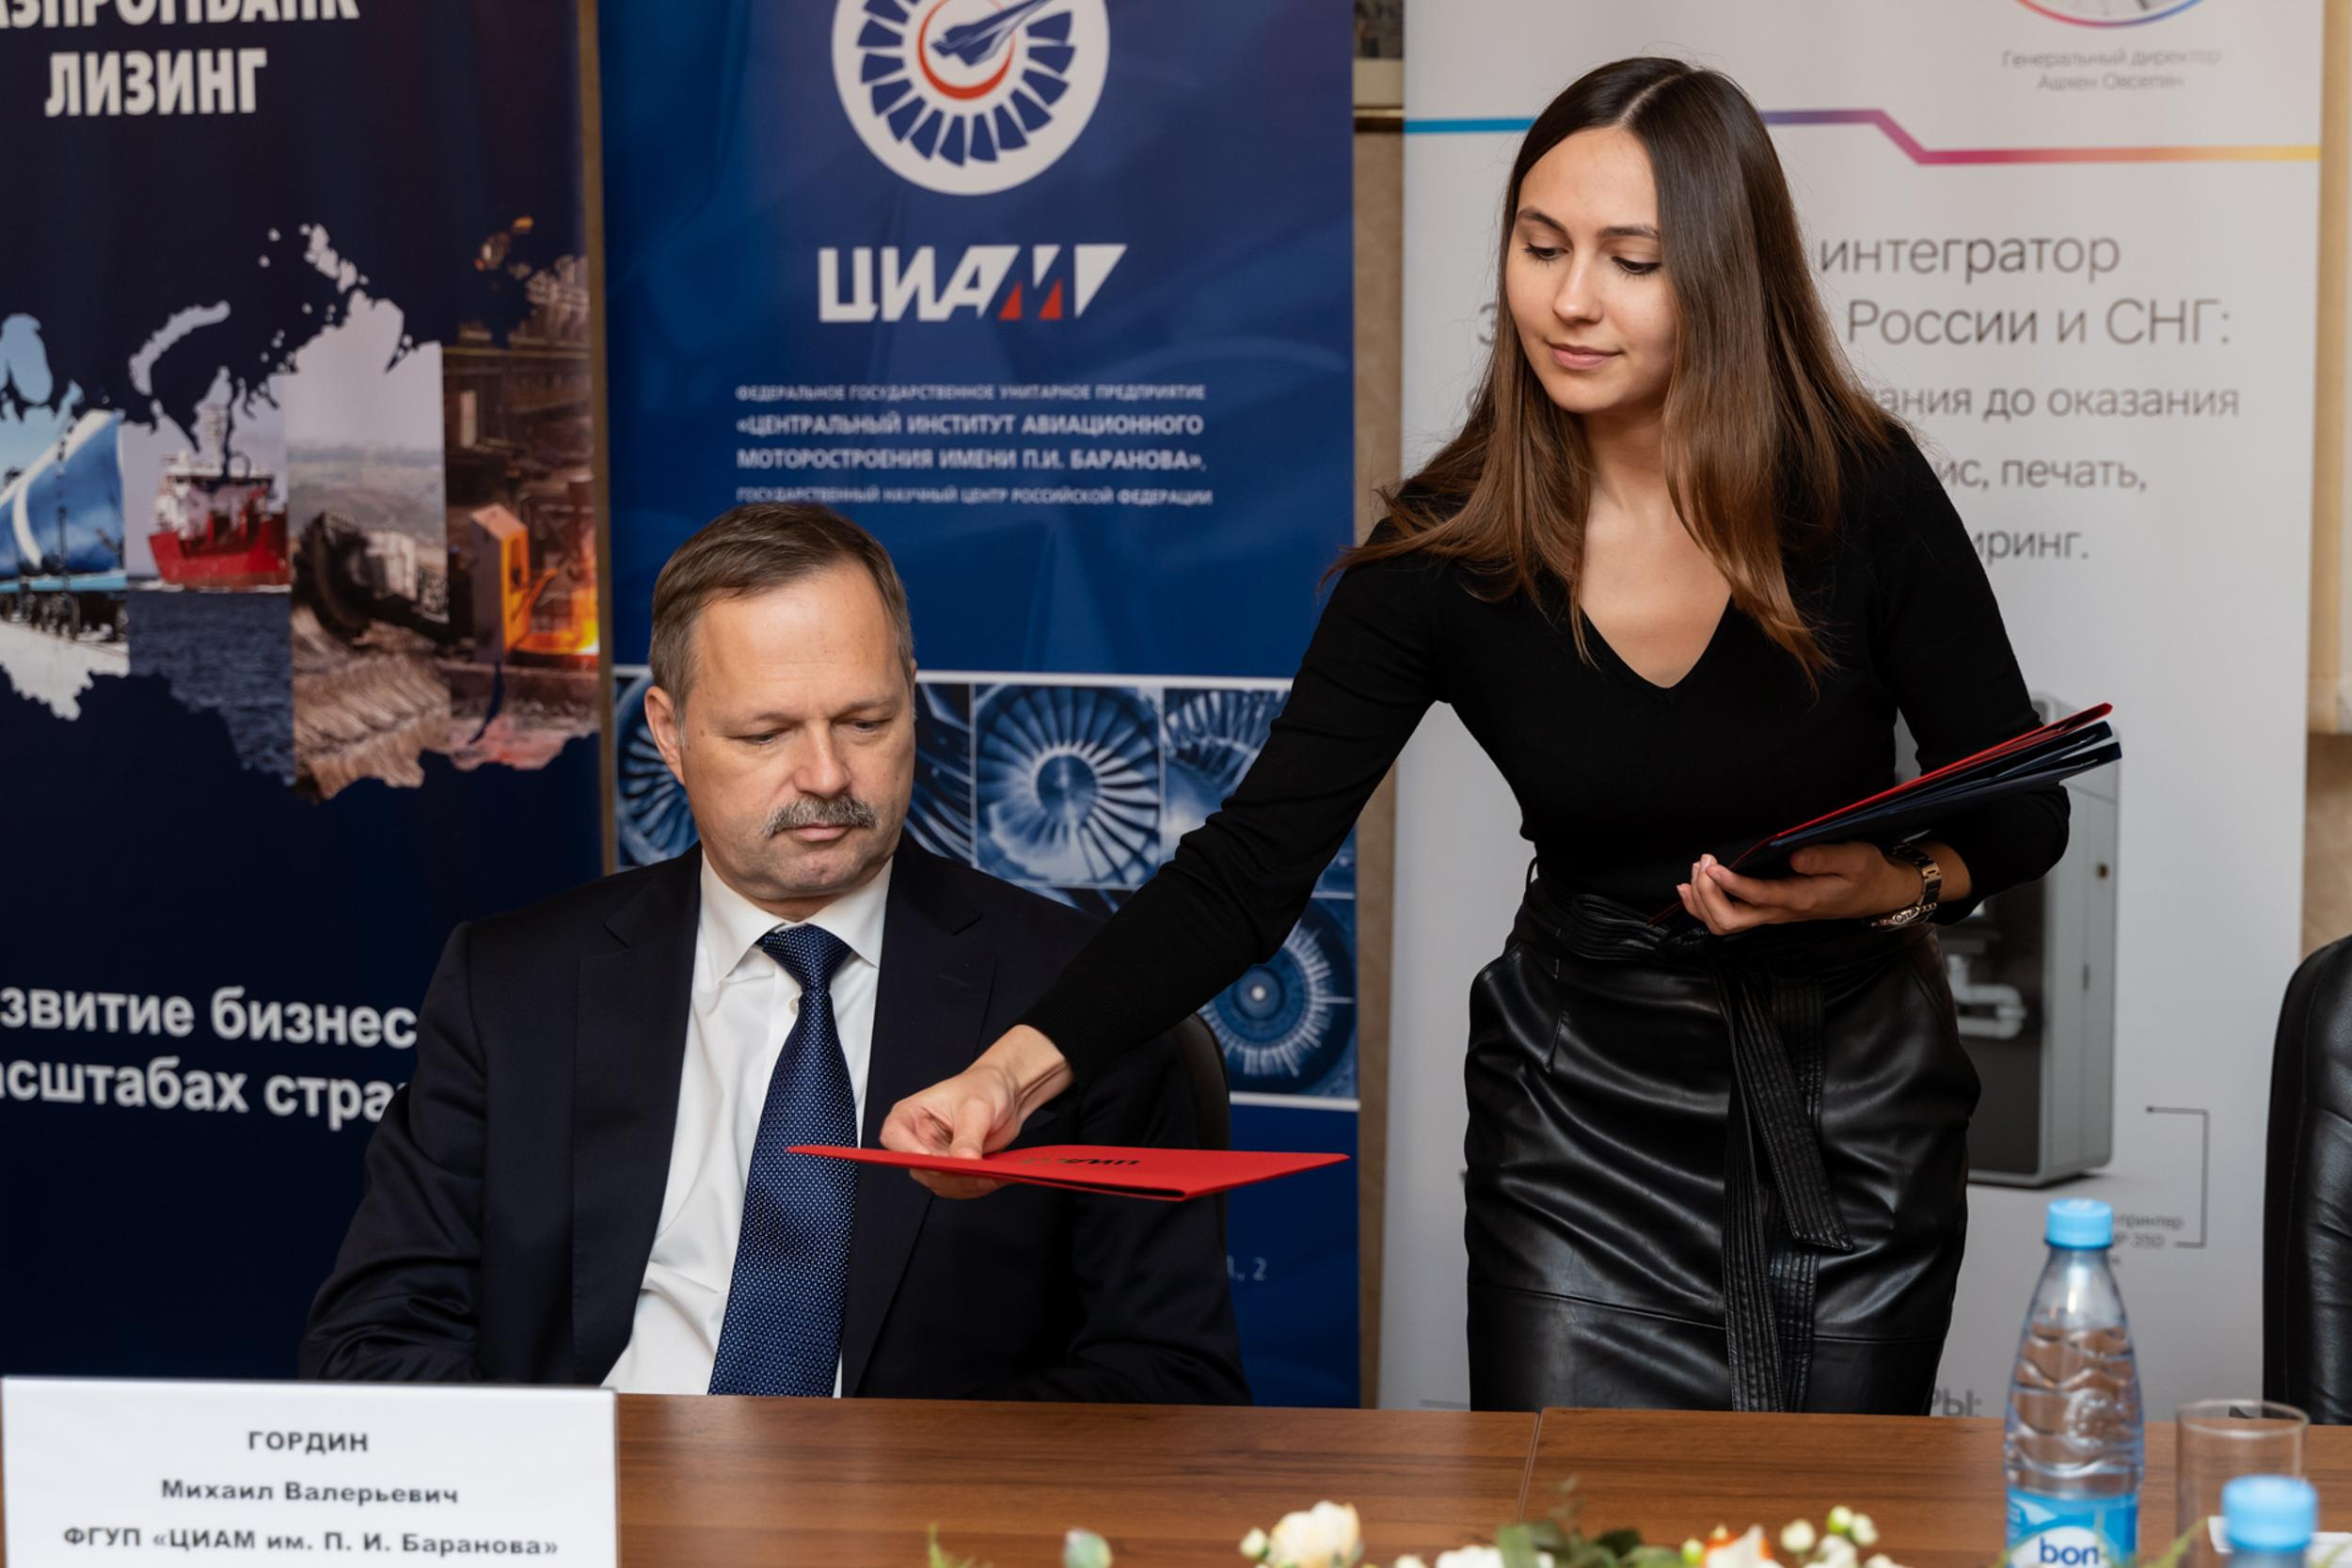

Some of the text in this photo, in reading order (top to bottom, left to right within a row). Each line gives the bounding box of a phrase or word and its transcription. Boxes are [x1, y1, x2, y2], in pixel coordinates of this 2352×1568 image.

[44, 47, 268, 118] ЛИЗИНГ
[1820, 237, 2122, 283] интегратор
[1847, 297, 2230, 345] России и СНГ:
[735, 384, 1205, 402] ФЕДЕРАЛЬНОЕ ГОСУДАРСТВЕННОЕ УНИТАРНОЕ ПРЕДПРИЯТИЕ
[1868, 387, 2239, 421] ания до оказания
[737, 411, 1204, 437] «ЦЕНТРАЛЬНЫЙ ИНСТИТУТ АВИАЦИОННОГО
[737, 449, 933, 469] МОТОРОСТРОЕНИЯ
[940, 449, 1017, 468] ИМЕНИ
[1023, 449, 1064, 468] П.И.
[2000, 458, 2147, 493] печать,
[1011, 485, 1114, 505] РОССИЙСКОЙ
[1117, 488, 1213, 506] ФЕДЕРАЦИИ
[211, 985, 418, 1049] бизнес
[263, 1073, 407, 1131] стра
[248, 1432, 369, 1454] ГОРДИН
[162, 1480, 458, 1506] Михаил Валерьевич
[64, 1528, 558, 1558] ФГУП «ЦИАМ им. П. И. Баранова»
